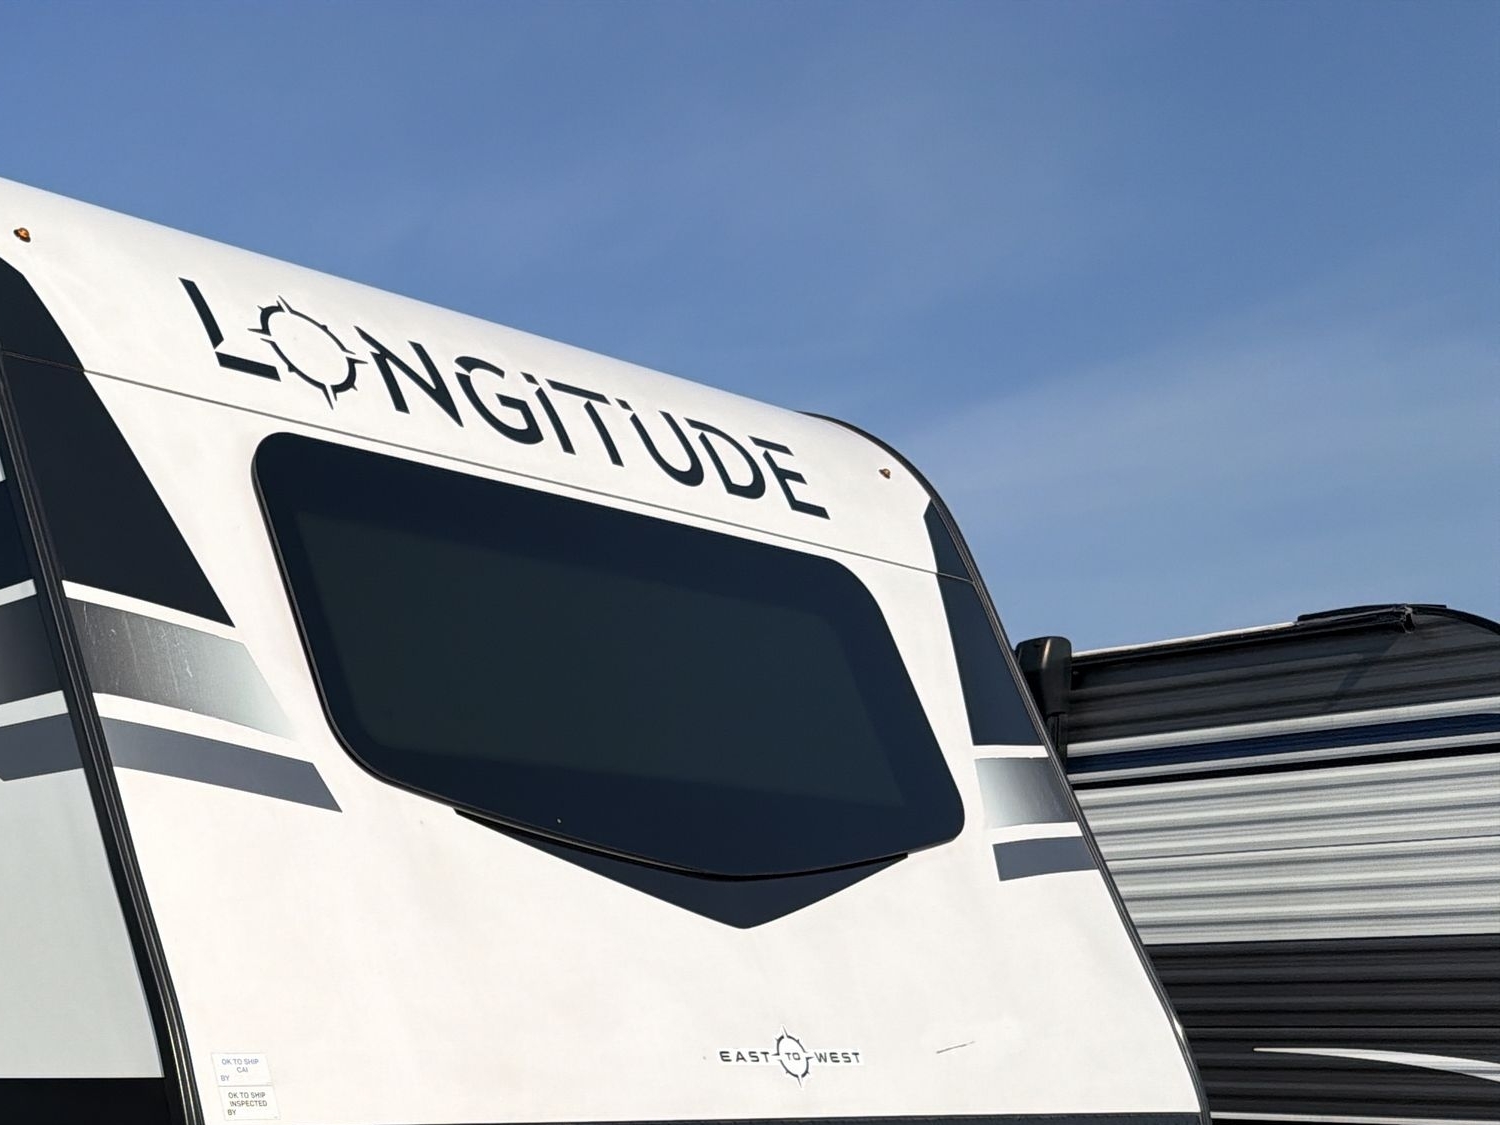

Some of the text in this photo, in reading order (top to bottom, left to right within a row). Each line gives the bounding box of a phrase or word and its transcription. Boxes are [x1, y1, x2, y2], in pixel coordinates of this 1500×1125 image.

[179, 277, 830, 520] LONGITUDE
[719, 1051, 860, 1063] EAST TO WEST
[228, 1091, 266, 1099] OK TO SHIP
